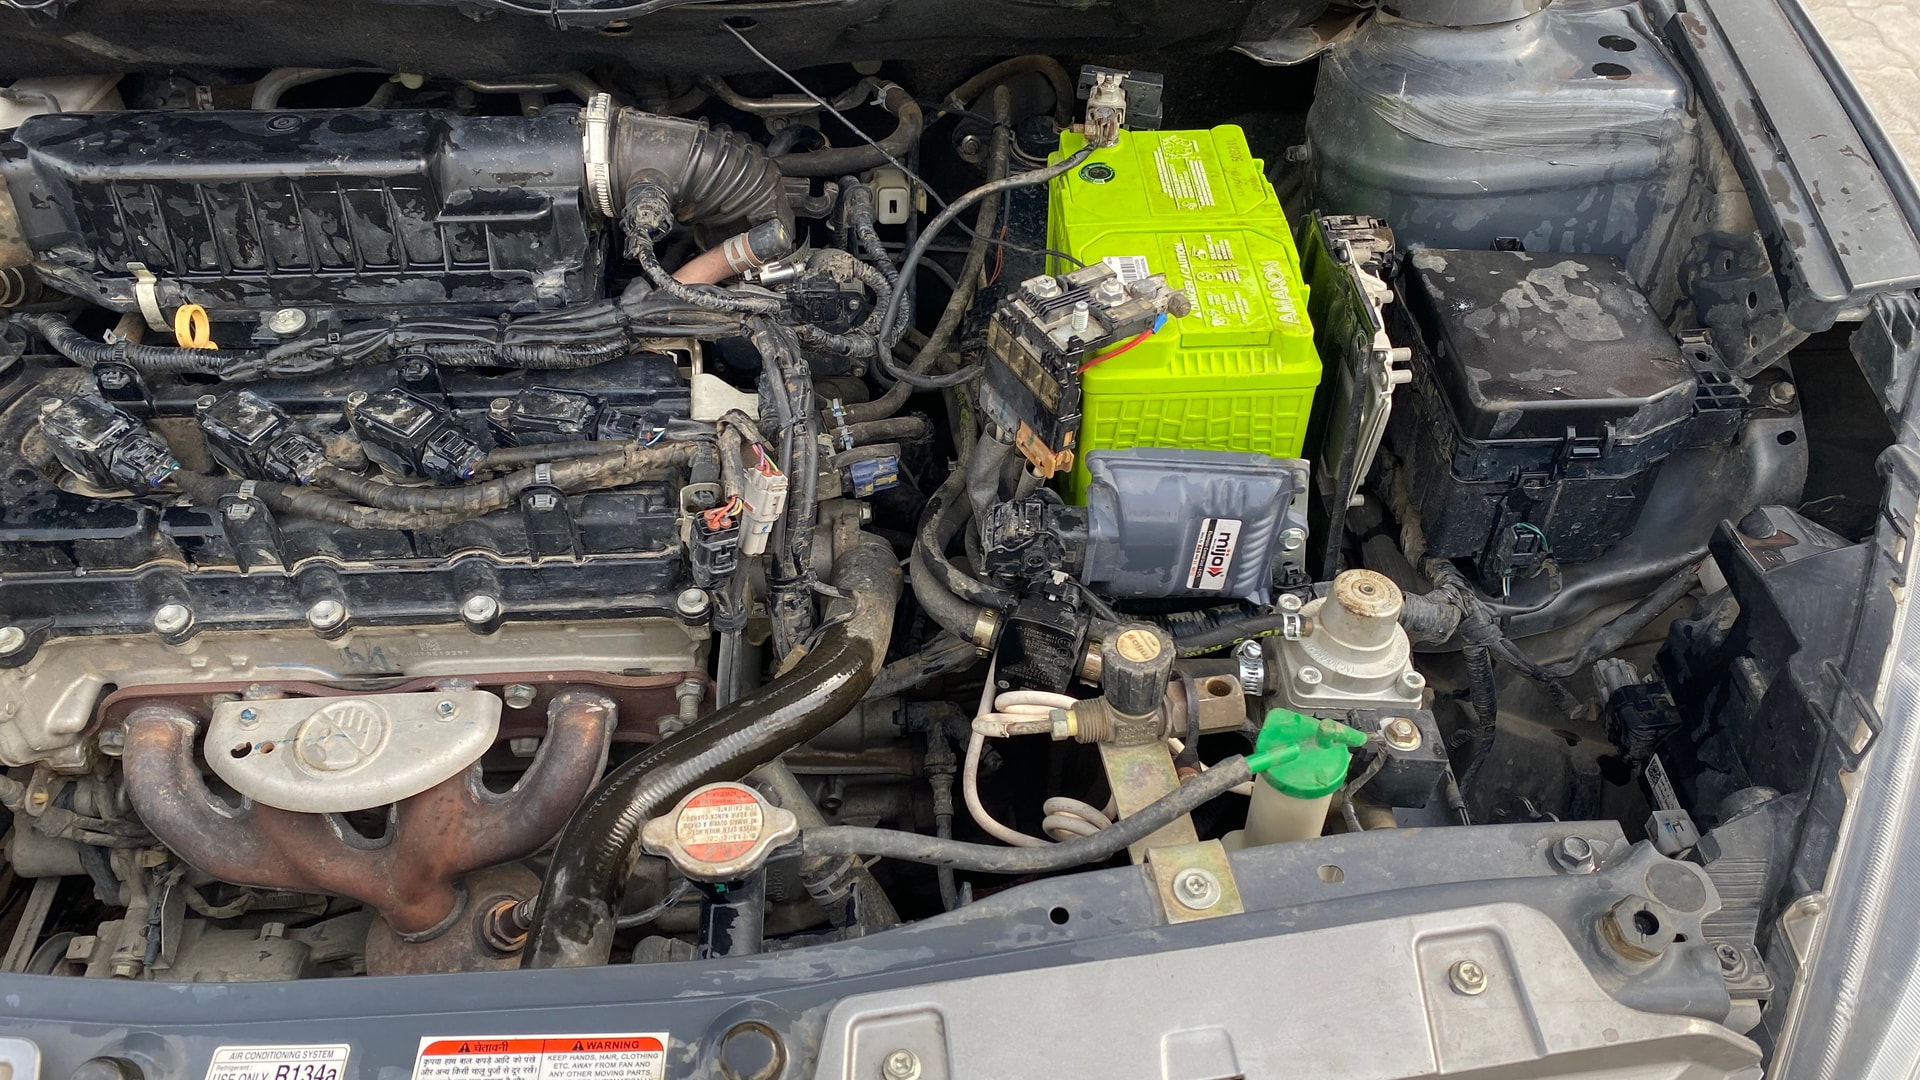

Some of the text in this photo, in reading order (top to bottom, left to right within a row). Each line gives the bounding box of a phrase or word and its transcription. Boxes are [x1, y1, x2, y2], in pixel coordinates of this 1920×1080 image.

[1175, 242, 1190, 274] CAUTION
[1184, 280, 1200, 310] DANGER
[1260, 260, 1300, 324] AMARON
[1211, 532, 1231, 566] mijo
[229, 1050, 335, 1060] AIR CONDITIONING SYSTEM
[474, 1041, 509, 1052] चेतावनी
[587, 1040, 640, 1050] WARNING
[275, 1064, 338, 1080] R134a
